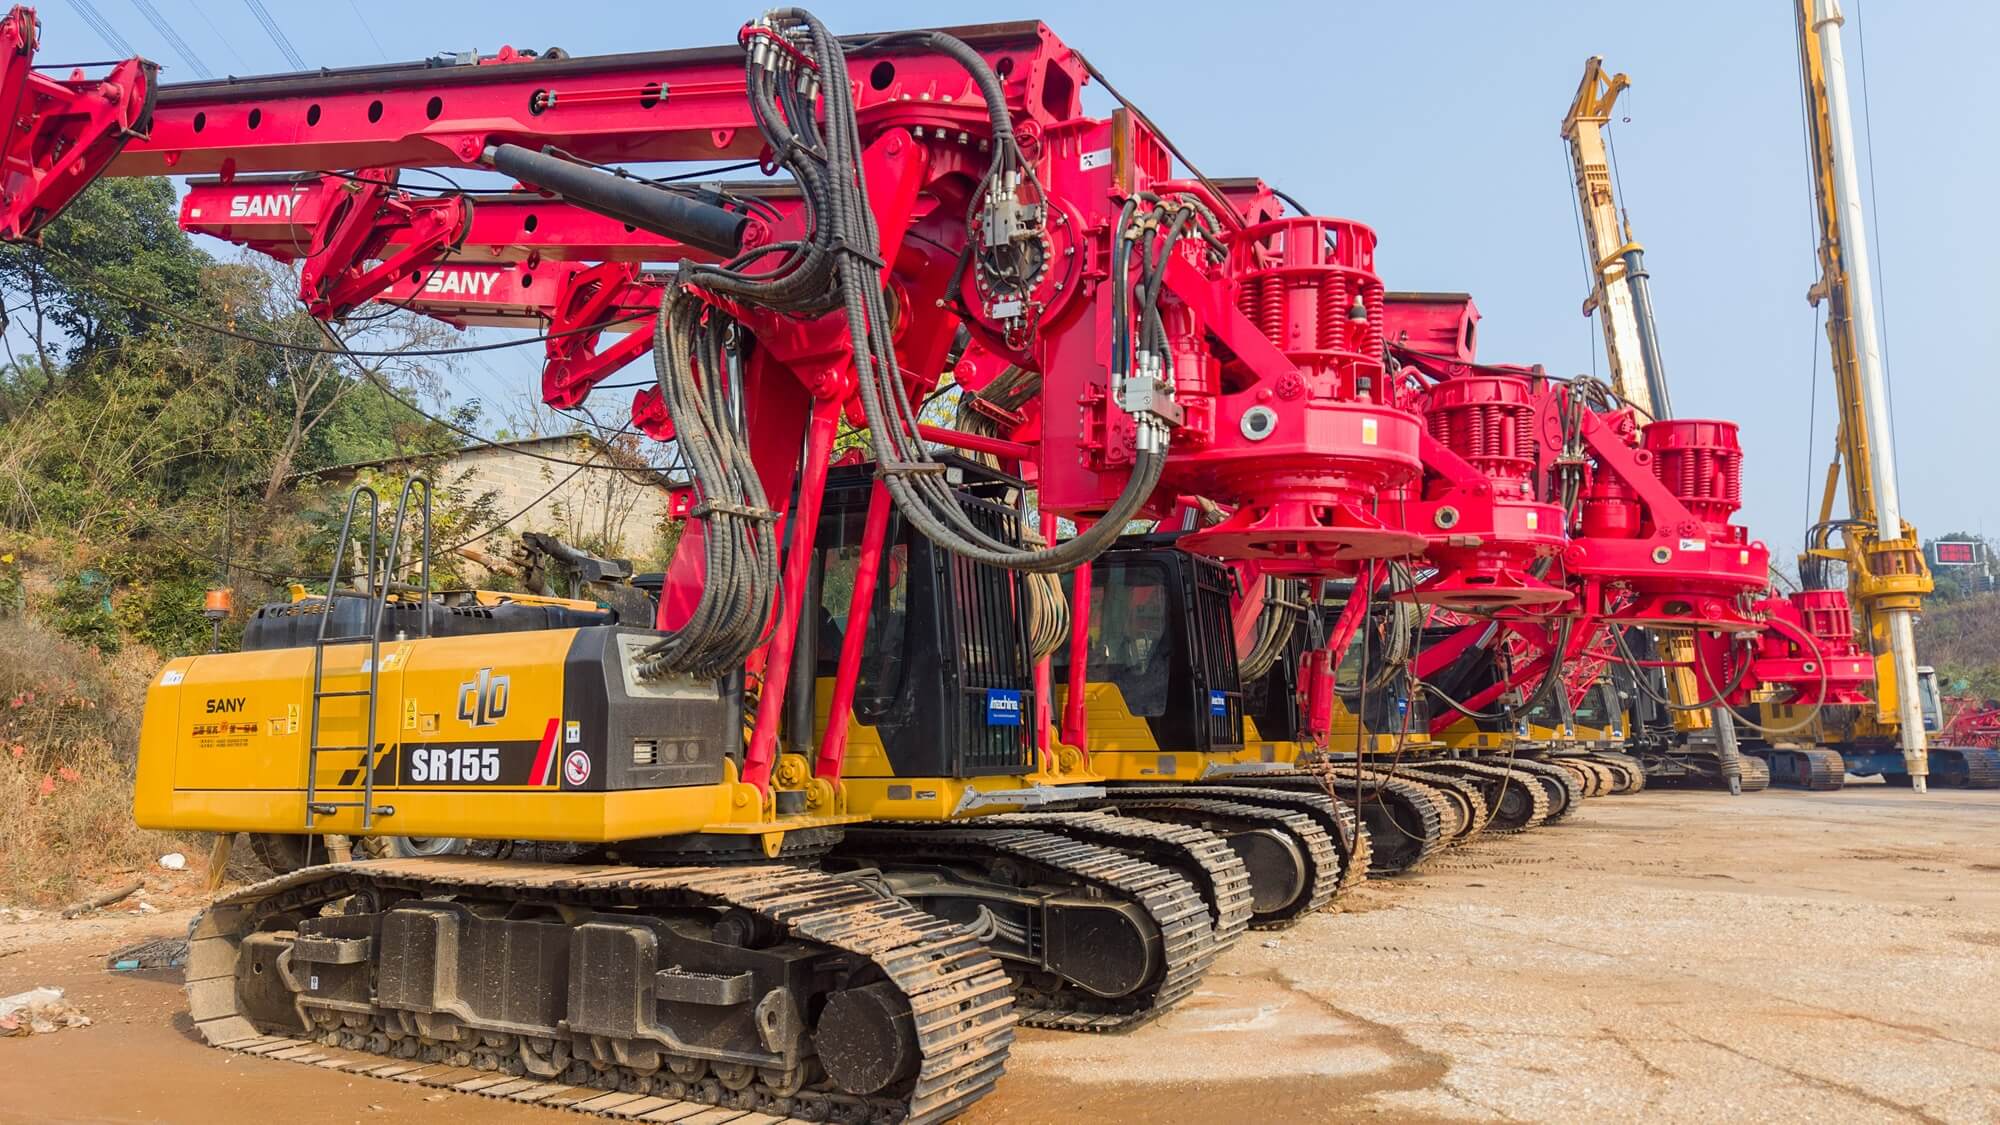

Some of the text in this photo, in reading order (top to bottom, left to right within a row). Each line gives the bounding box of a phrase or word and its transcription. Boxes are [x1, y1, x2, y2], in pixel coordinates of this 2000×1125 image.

[230, 194, 302, 217] SANY
[425, 270, 500, 295] SANY
[206, 697, 246, 713] SANY
[411, 748, 500, 781] SR155
